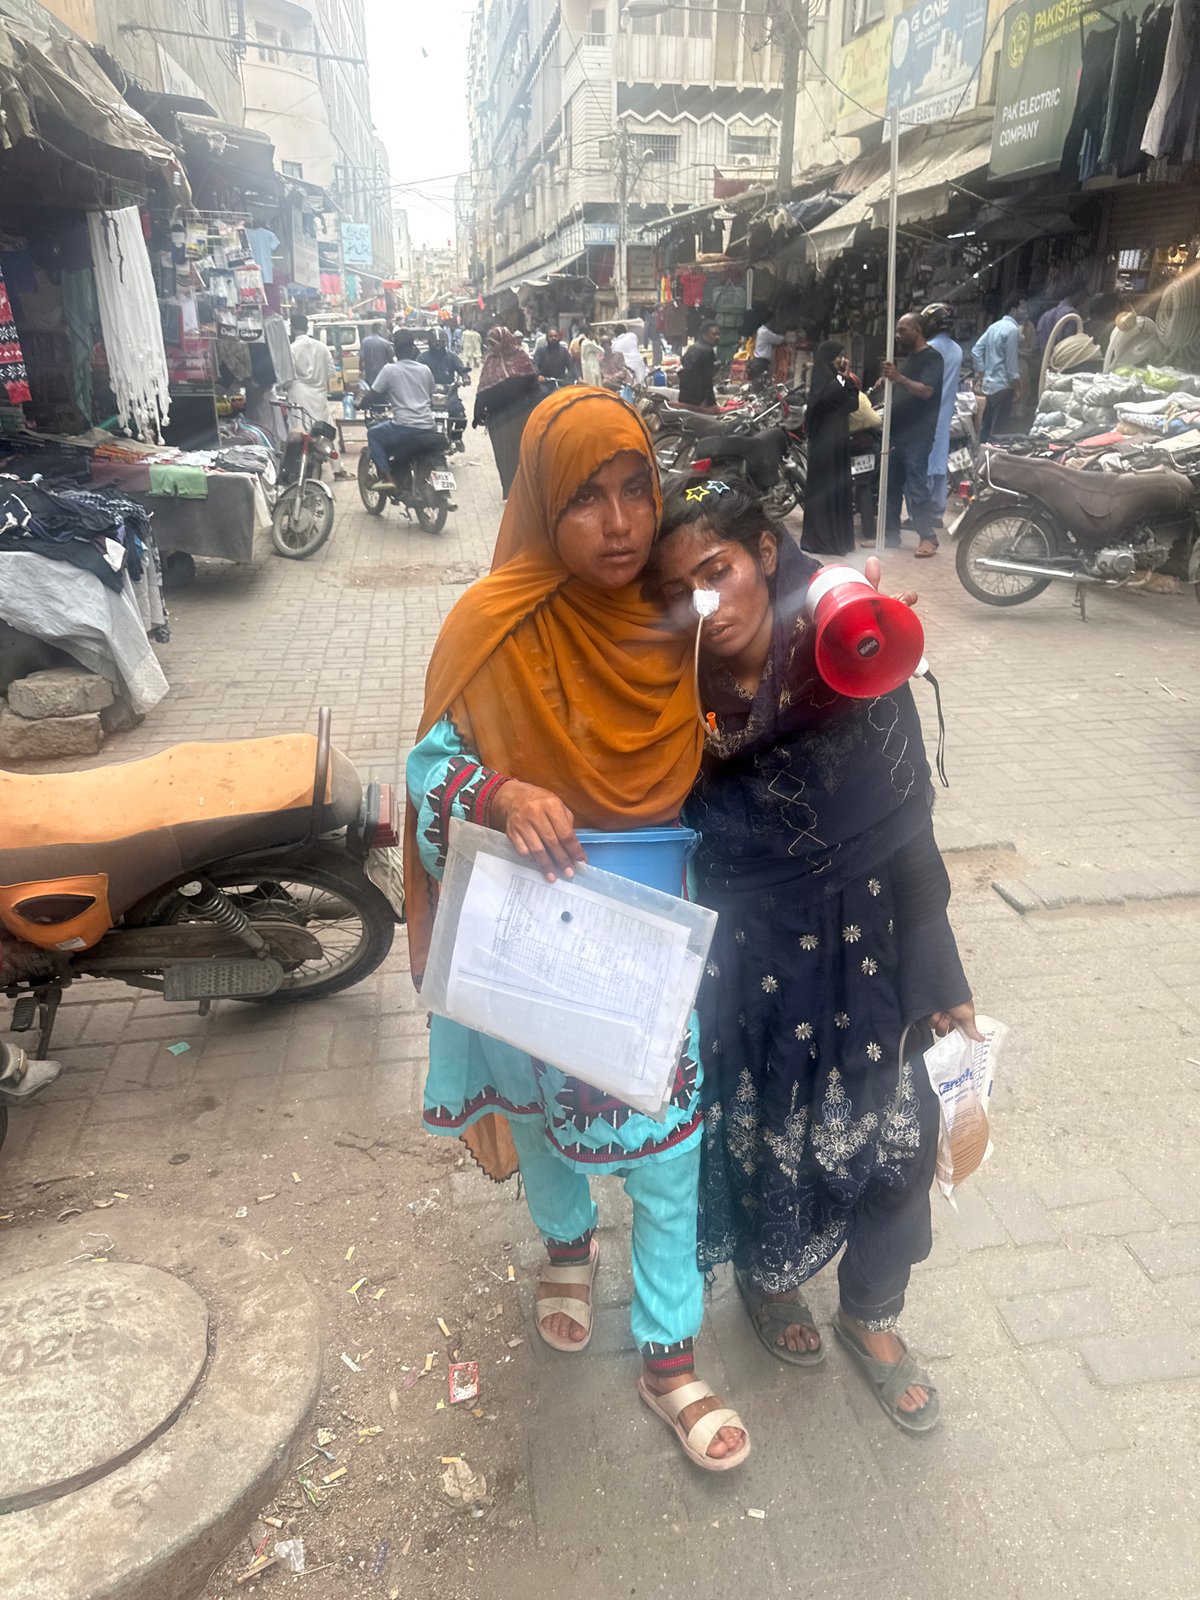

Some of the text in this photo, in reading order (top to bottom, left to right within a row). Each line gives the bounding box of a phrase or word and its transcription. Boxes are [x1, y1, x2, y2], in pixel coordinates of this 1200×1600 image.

[1002, 87, 1060, 123] PAK ELECTRIC
[1000, 120, 1040, 147] COMPANY
